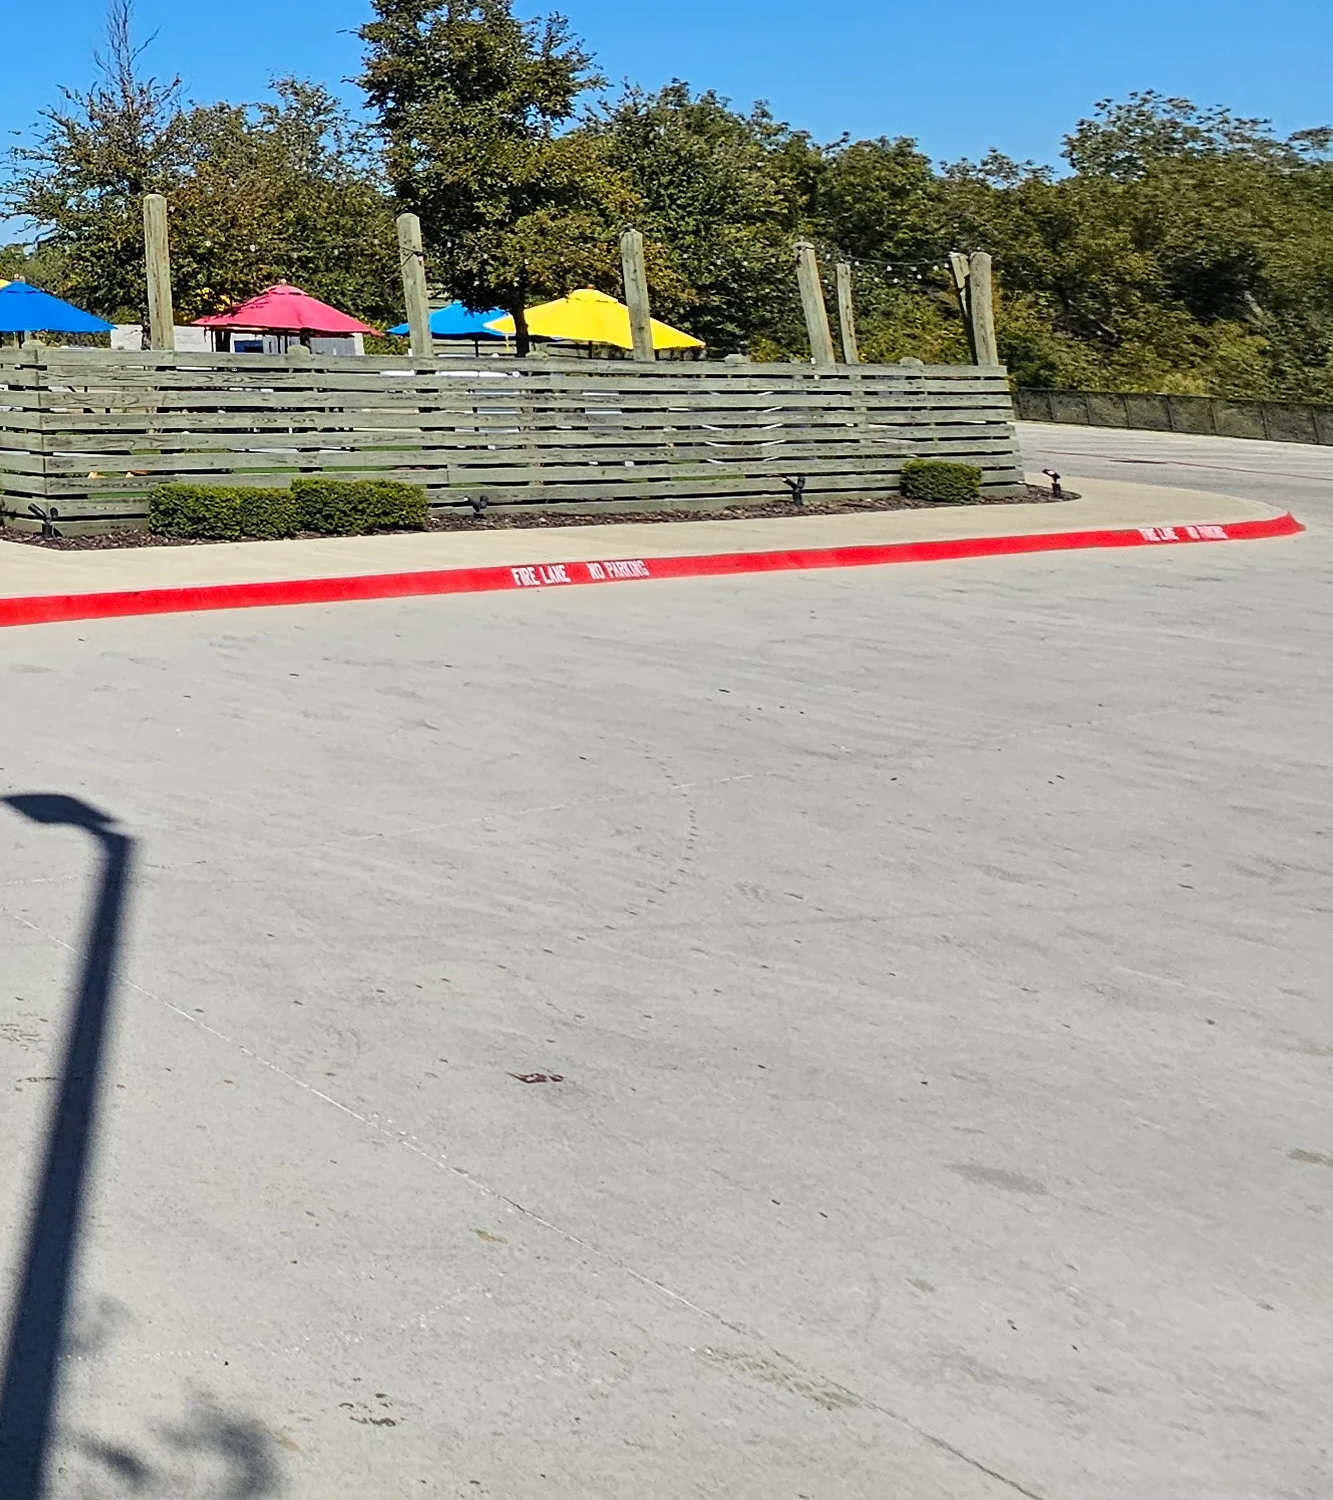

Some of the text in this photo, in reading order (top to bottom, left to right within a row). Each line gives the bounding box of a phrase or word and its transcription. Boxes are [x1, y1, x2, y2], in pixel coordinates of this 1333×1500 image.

[511, 559, 650, 586] FIRE LANE NO PARKING
